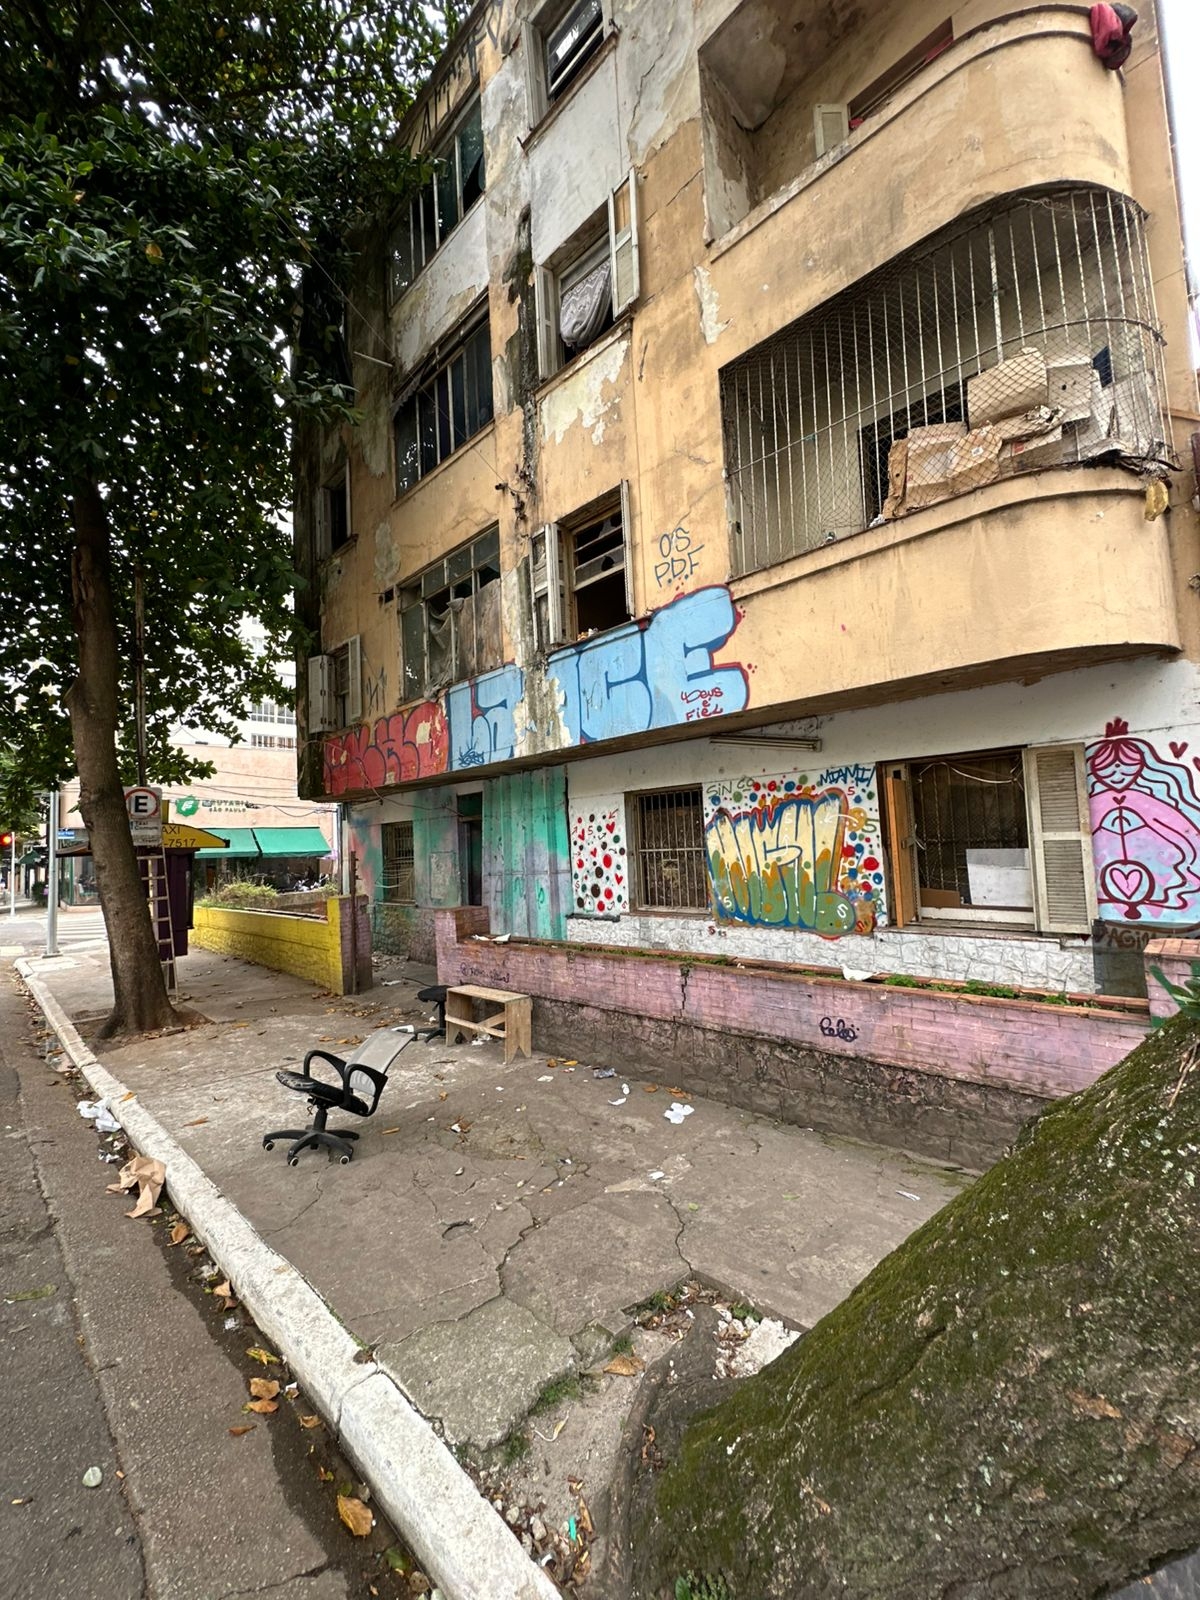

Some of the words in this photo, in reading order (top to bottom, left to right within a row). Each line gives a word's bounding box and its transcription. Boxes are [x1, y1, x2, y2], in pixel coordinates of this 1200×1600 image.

[134, 795, 148, 813] E
[162, 825, 181, 835] AXI
[163, 838, 197, 848] -7517
